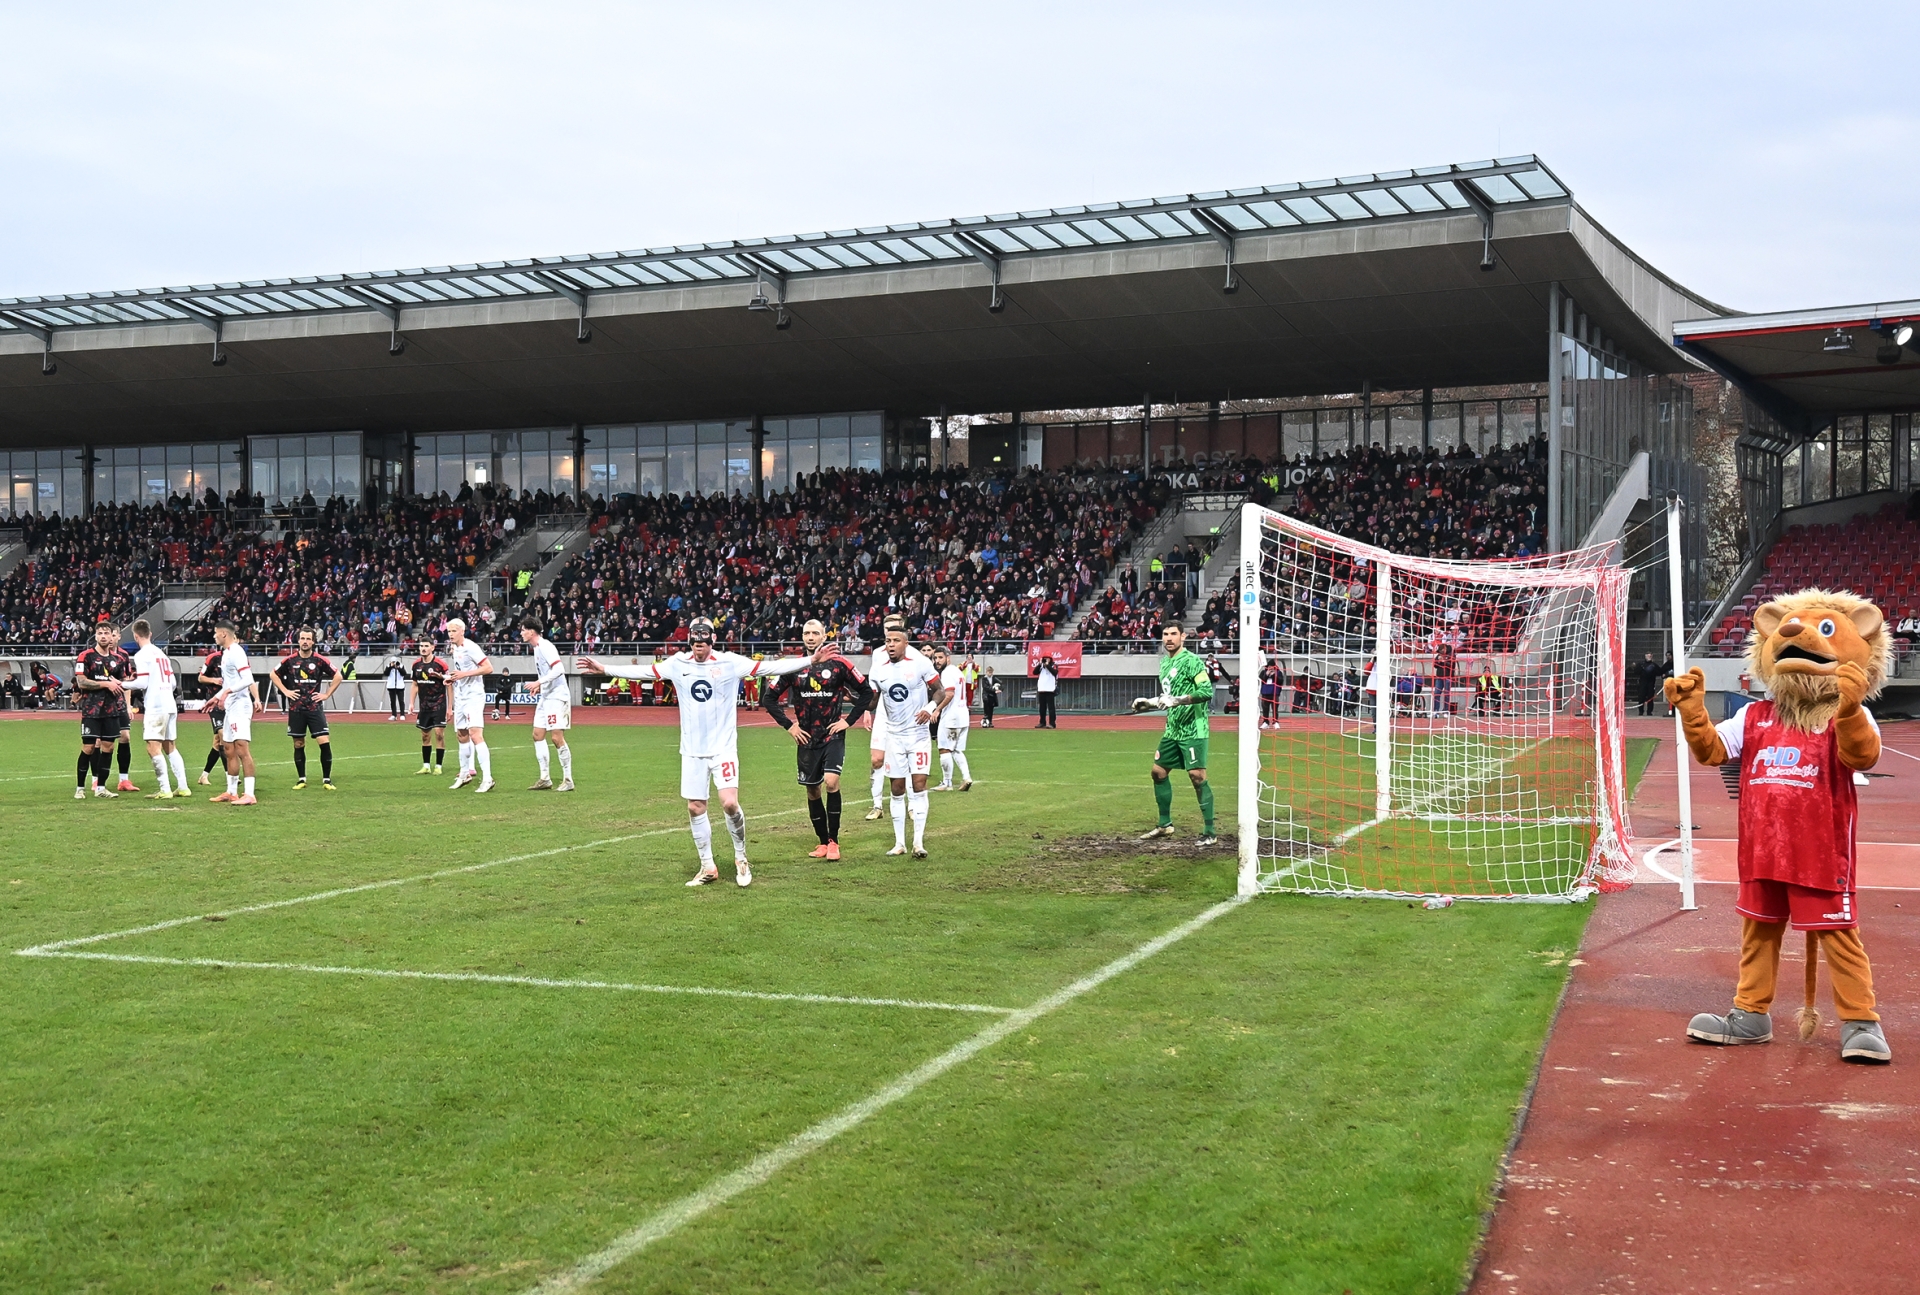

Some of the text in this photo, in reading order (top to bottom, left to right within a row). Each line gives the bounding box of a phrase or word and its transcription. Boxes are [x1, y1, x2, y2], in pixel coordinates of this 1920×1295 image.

[1245, 560, 1256, 590] artec
[156, 658, 171, 684] 14
[547, 714, 557, 725] 23
[916, 752, 928, 766] 31
[1188, 747, 1196, 760] 1
[1764, 745, 1801, 766] HD
[721, 761, 736, 777] 21
